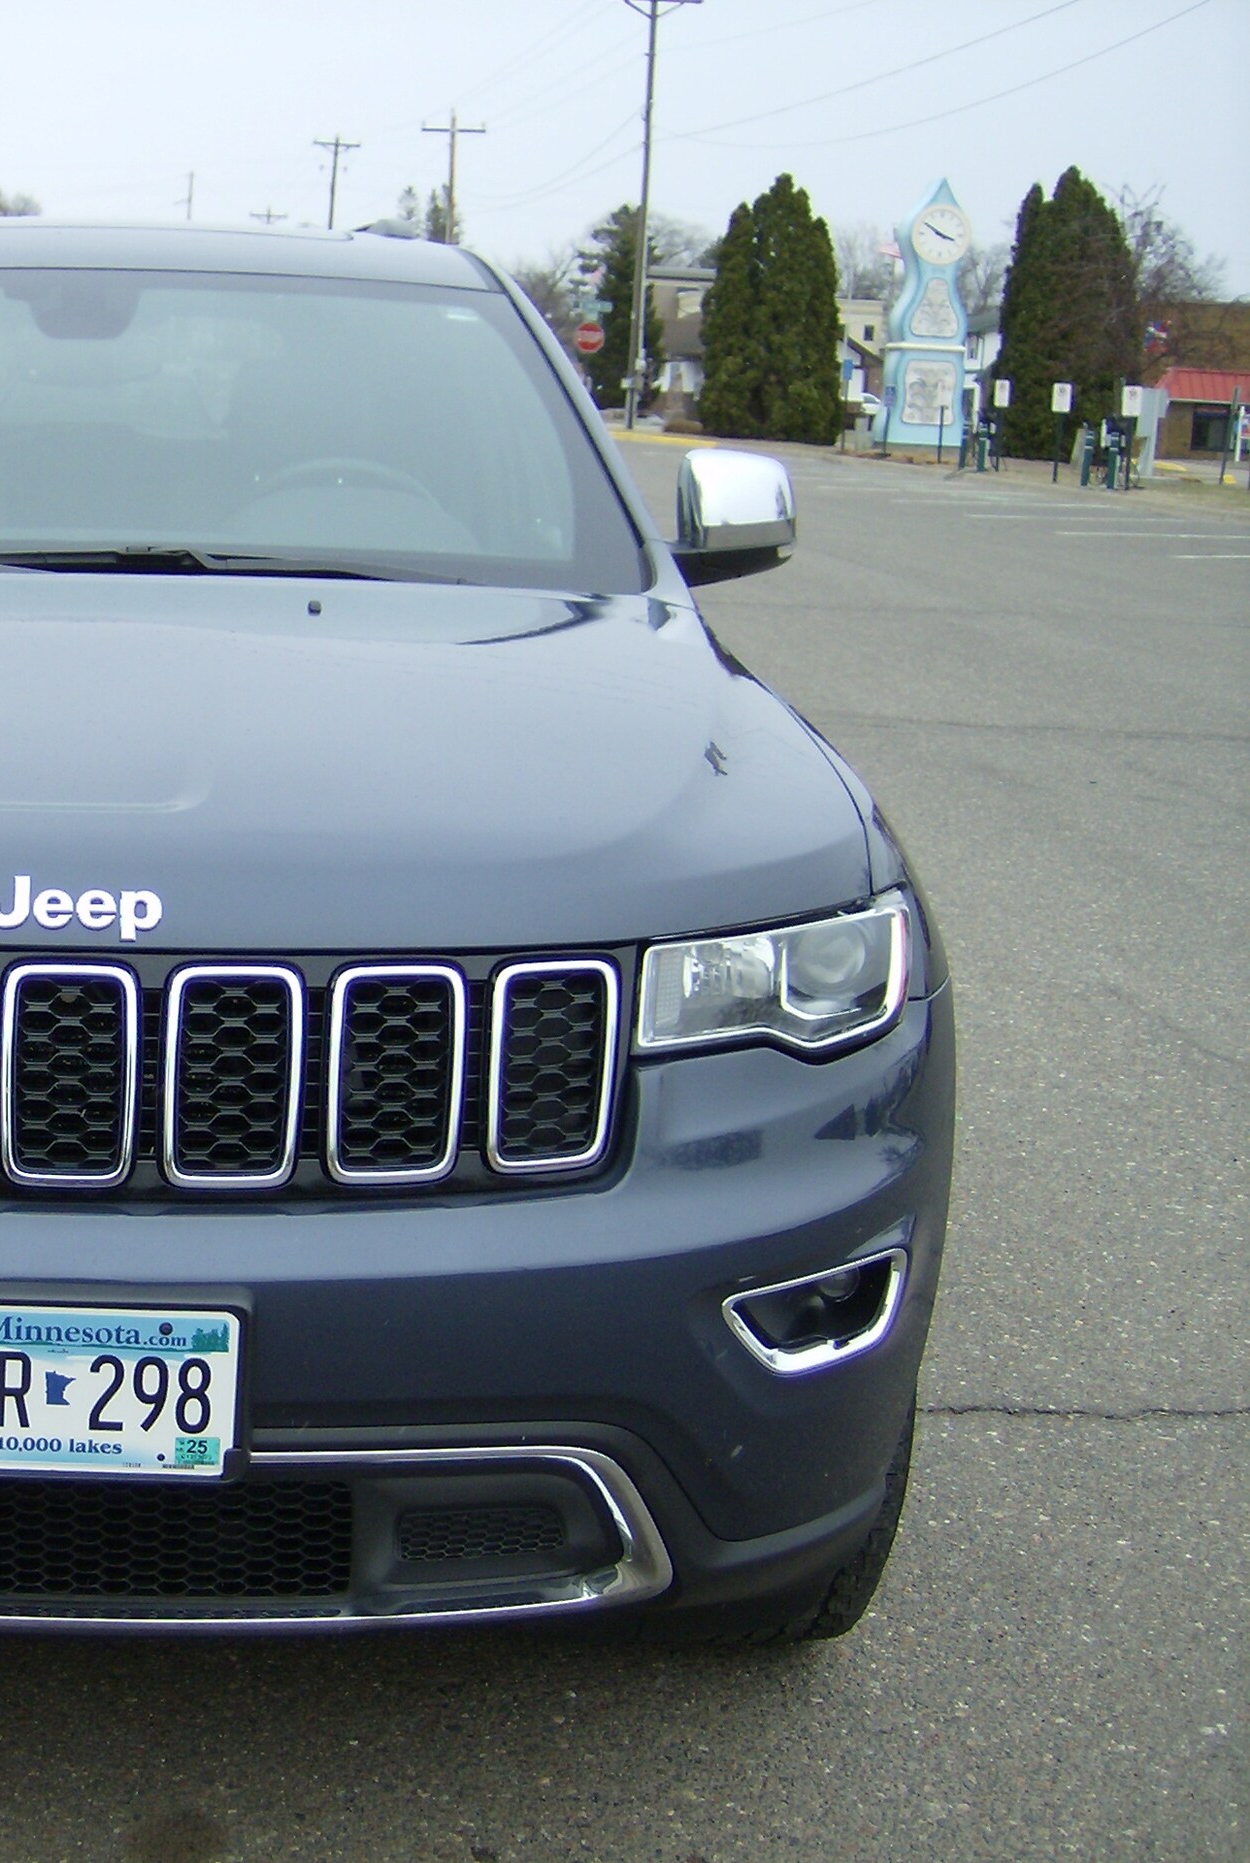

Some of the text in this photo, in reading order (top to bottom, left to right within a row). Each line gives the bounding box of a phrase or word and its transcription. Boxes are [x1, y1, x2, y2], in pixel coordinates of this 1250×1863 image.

[88, 1354, 211, 1434] 298
[69, 1436, 123, 1455] lakes
[187, 1439, 208, 1454] 25
